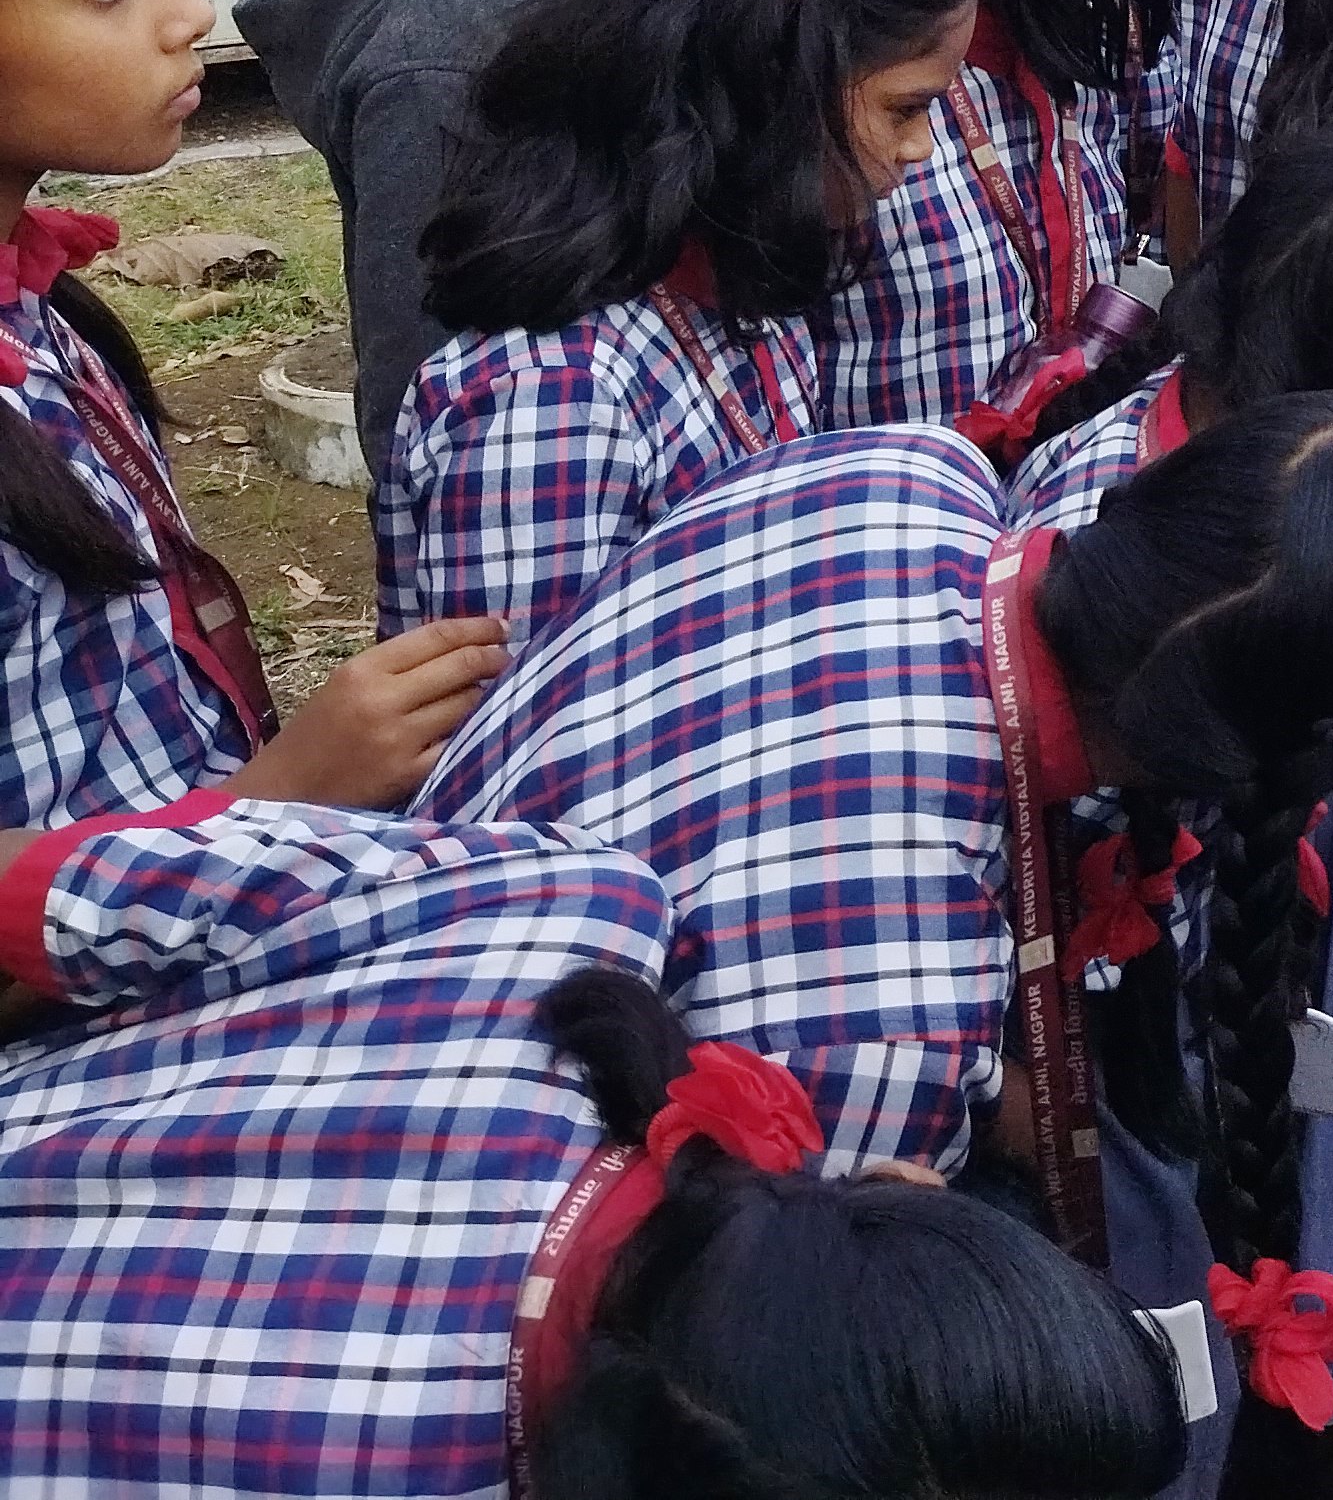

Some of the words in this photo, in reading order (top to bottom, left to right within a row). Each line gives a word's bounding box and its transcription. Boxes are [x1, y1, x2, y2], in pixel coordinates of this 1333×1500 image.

[991, 595, 1011, 672] NAGPUR
[1000, 674, 1021, 729] AJNI,
[1011, 734, 1034, 845] VIDYALAYA,
[1020, 848, 1037, 938] KENDRIYA
[1028, 982, 1045, 1059] NAGPUR
[543, 1178, 603, 1257] नागपुर
[507, 1347, 525, 1446] NAGPUR
